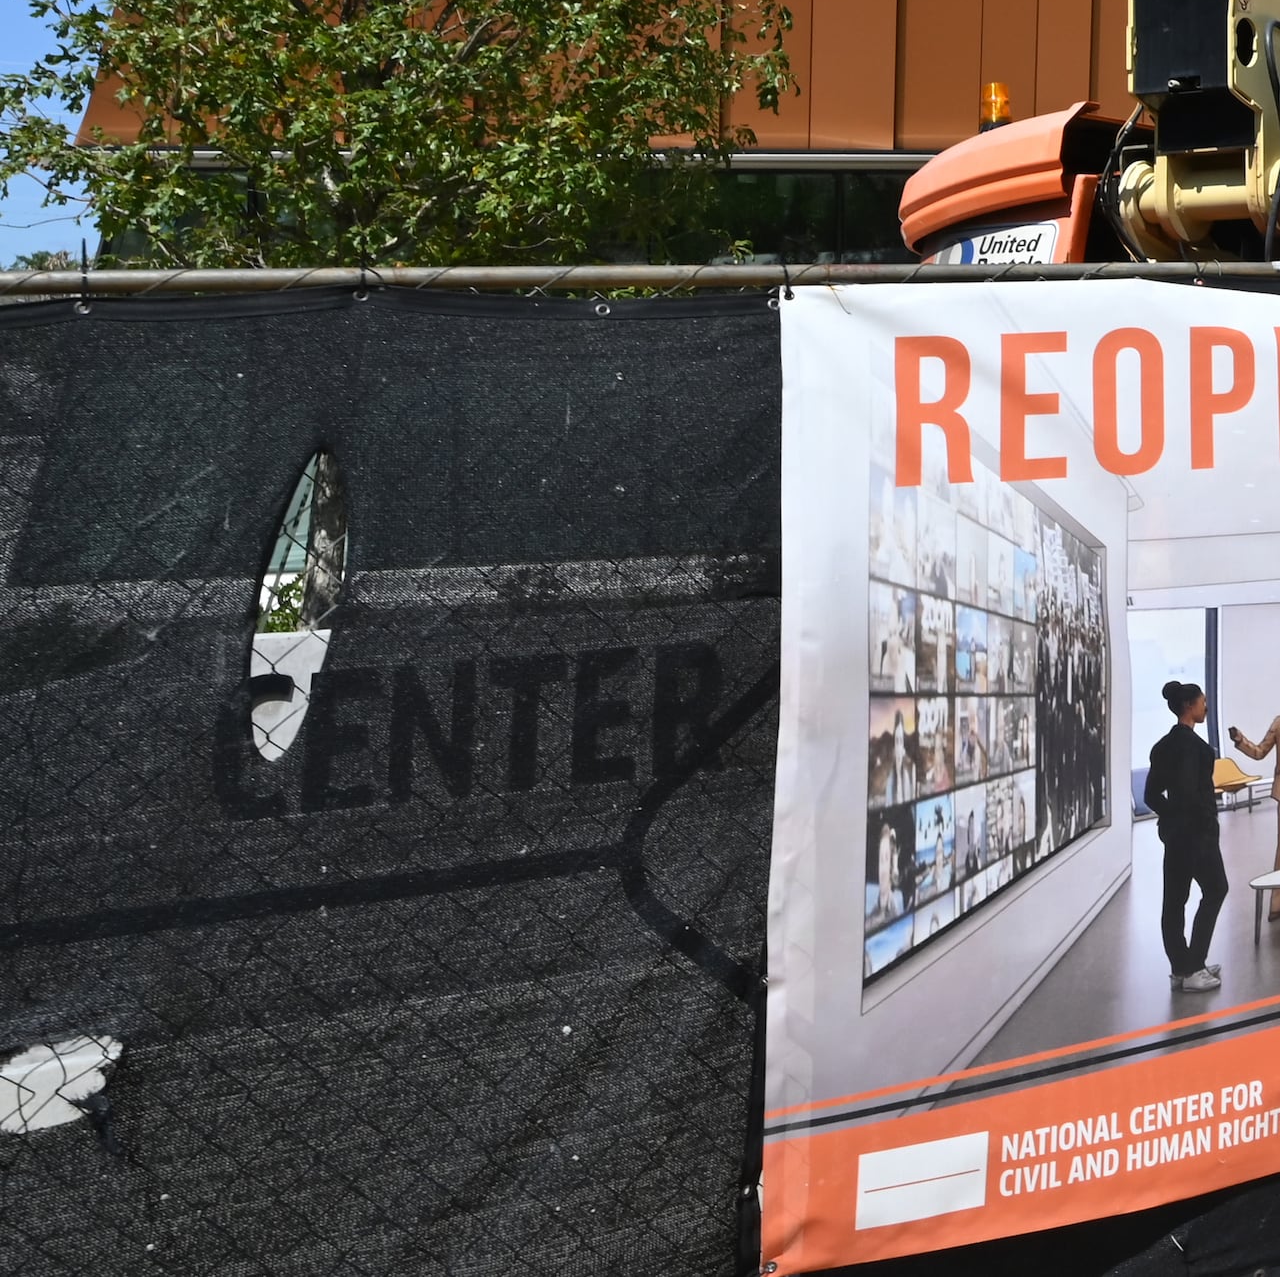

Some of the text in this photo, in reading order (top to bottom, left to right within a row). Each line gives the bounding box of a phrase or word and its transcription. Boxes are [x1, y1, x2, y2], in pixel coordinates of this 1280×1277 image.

[979, 233, 1042, 255] United
[212, 642, 725, 822] CENTER
[1001, 1080, 1263, 1162] NATIONAL CENTER FOR
[999, 1160, 1062, 1197] CIVIL
[1067, 1148, 1120, 1184] AND
[1125, 1126, 1212, 1172] HUMAN
